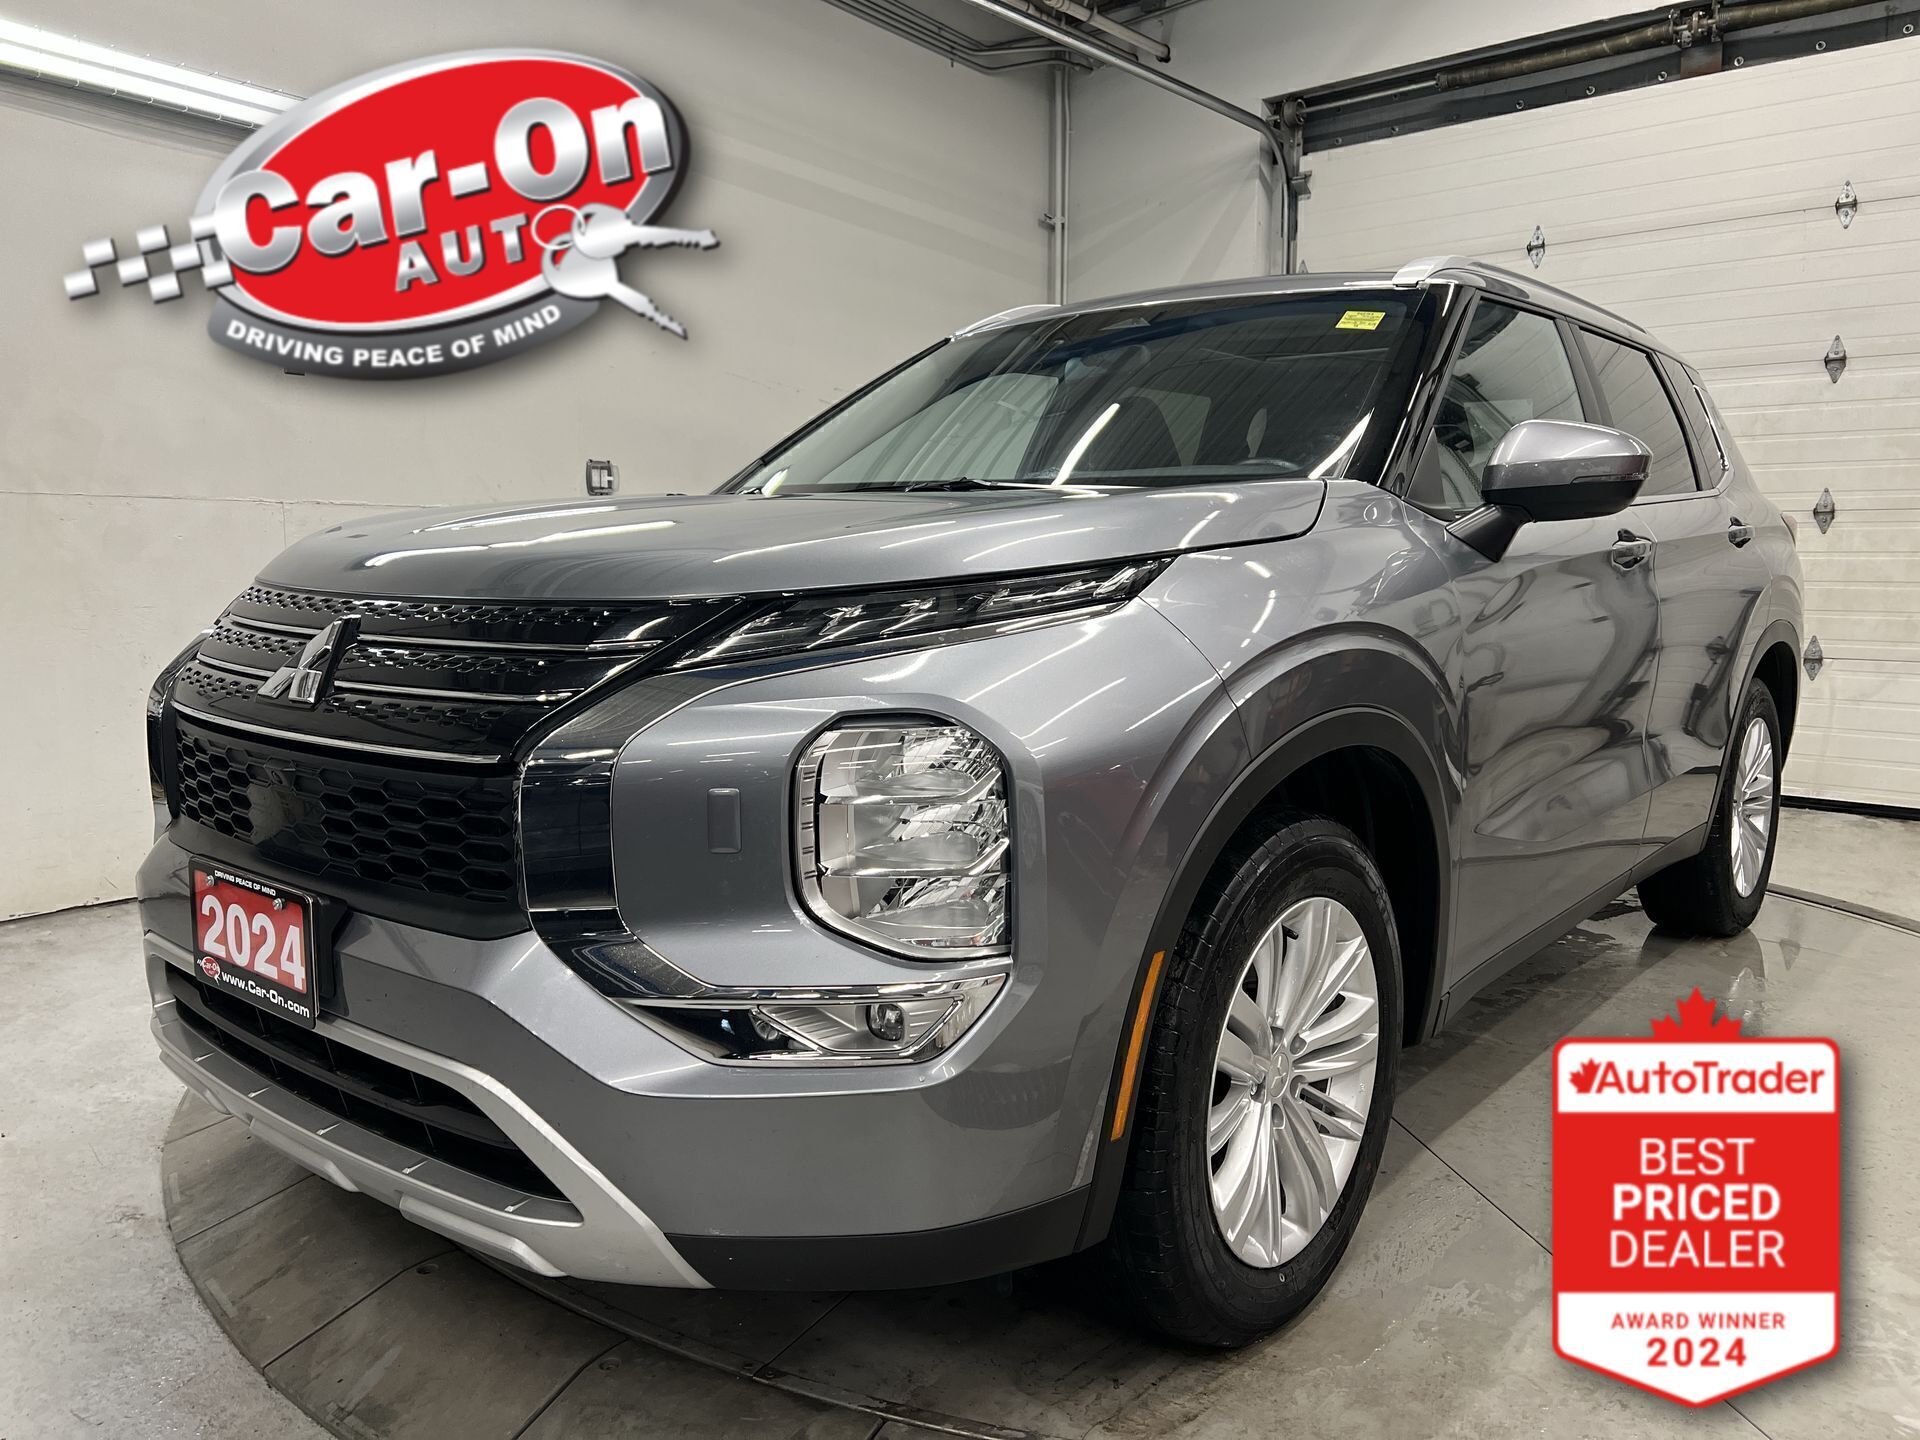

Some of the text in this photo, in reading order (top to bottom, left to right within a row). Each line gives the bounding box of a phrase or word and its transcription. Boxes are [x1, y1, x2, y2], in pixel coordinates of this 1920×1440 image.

[214, 870, 234, 882] DRIVING
[235, 877, 252, 888] PEACE
[261, 885, 276, 896] MIND
[202, 894, 305, 990] 2024
[221, 971, 310, 1018] www.Car-On.com
